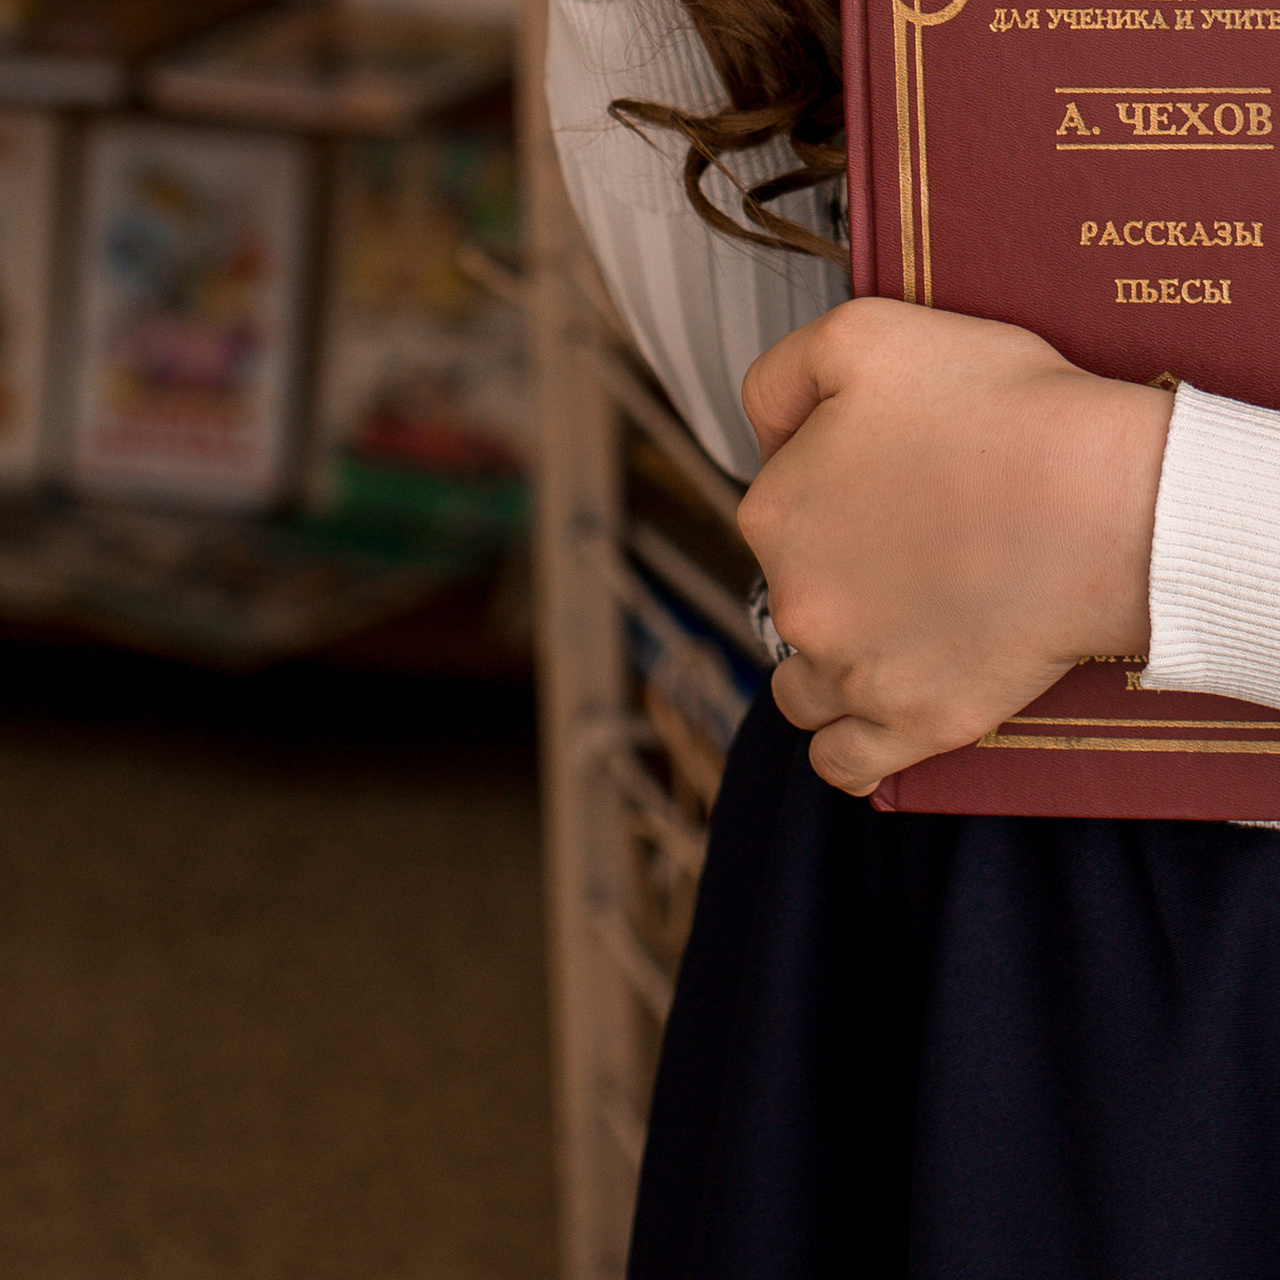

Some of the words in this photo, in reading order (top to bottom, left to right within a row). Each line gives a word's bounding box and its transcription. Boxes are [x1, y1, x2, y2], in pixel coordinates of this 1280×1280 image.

[989, 8, 1040, 32] ДЛЯ
[1046, 8, 1170, 30] УЧЕНИКА
[1174, 9, 1195, 30] И
[1056, 101, 1101, 136] А.
[1115, 101, 1274, 136] ЧЕХОВ
[1079, 220, 1264, 247] РАССКАЗЫ
[1114, 278, 1232, 304] ПЬЕСЫ
